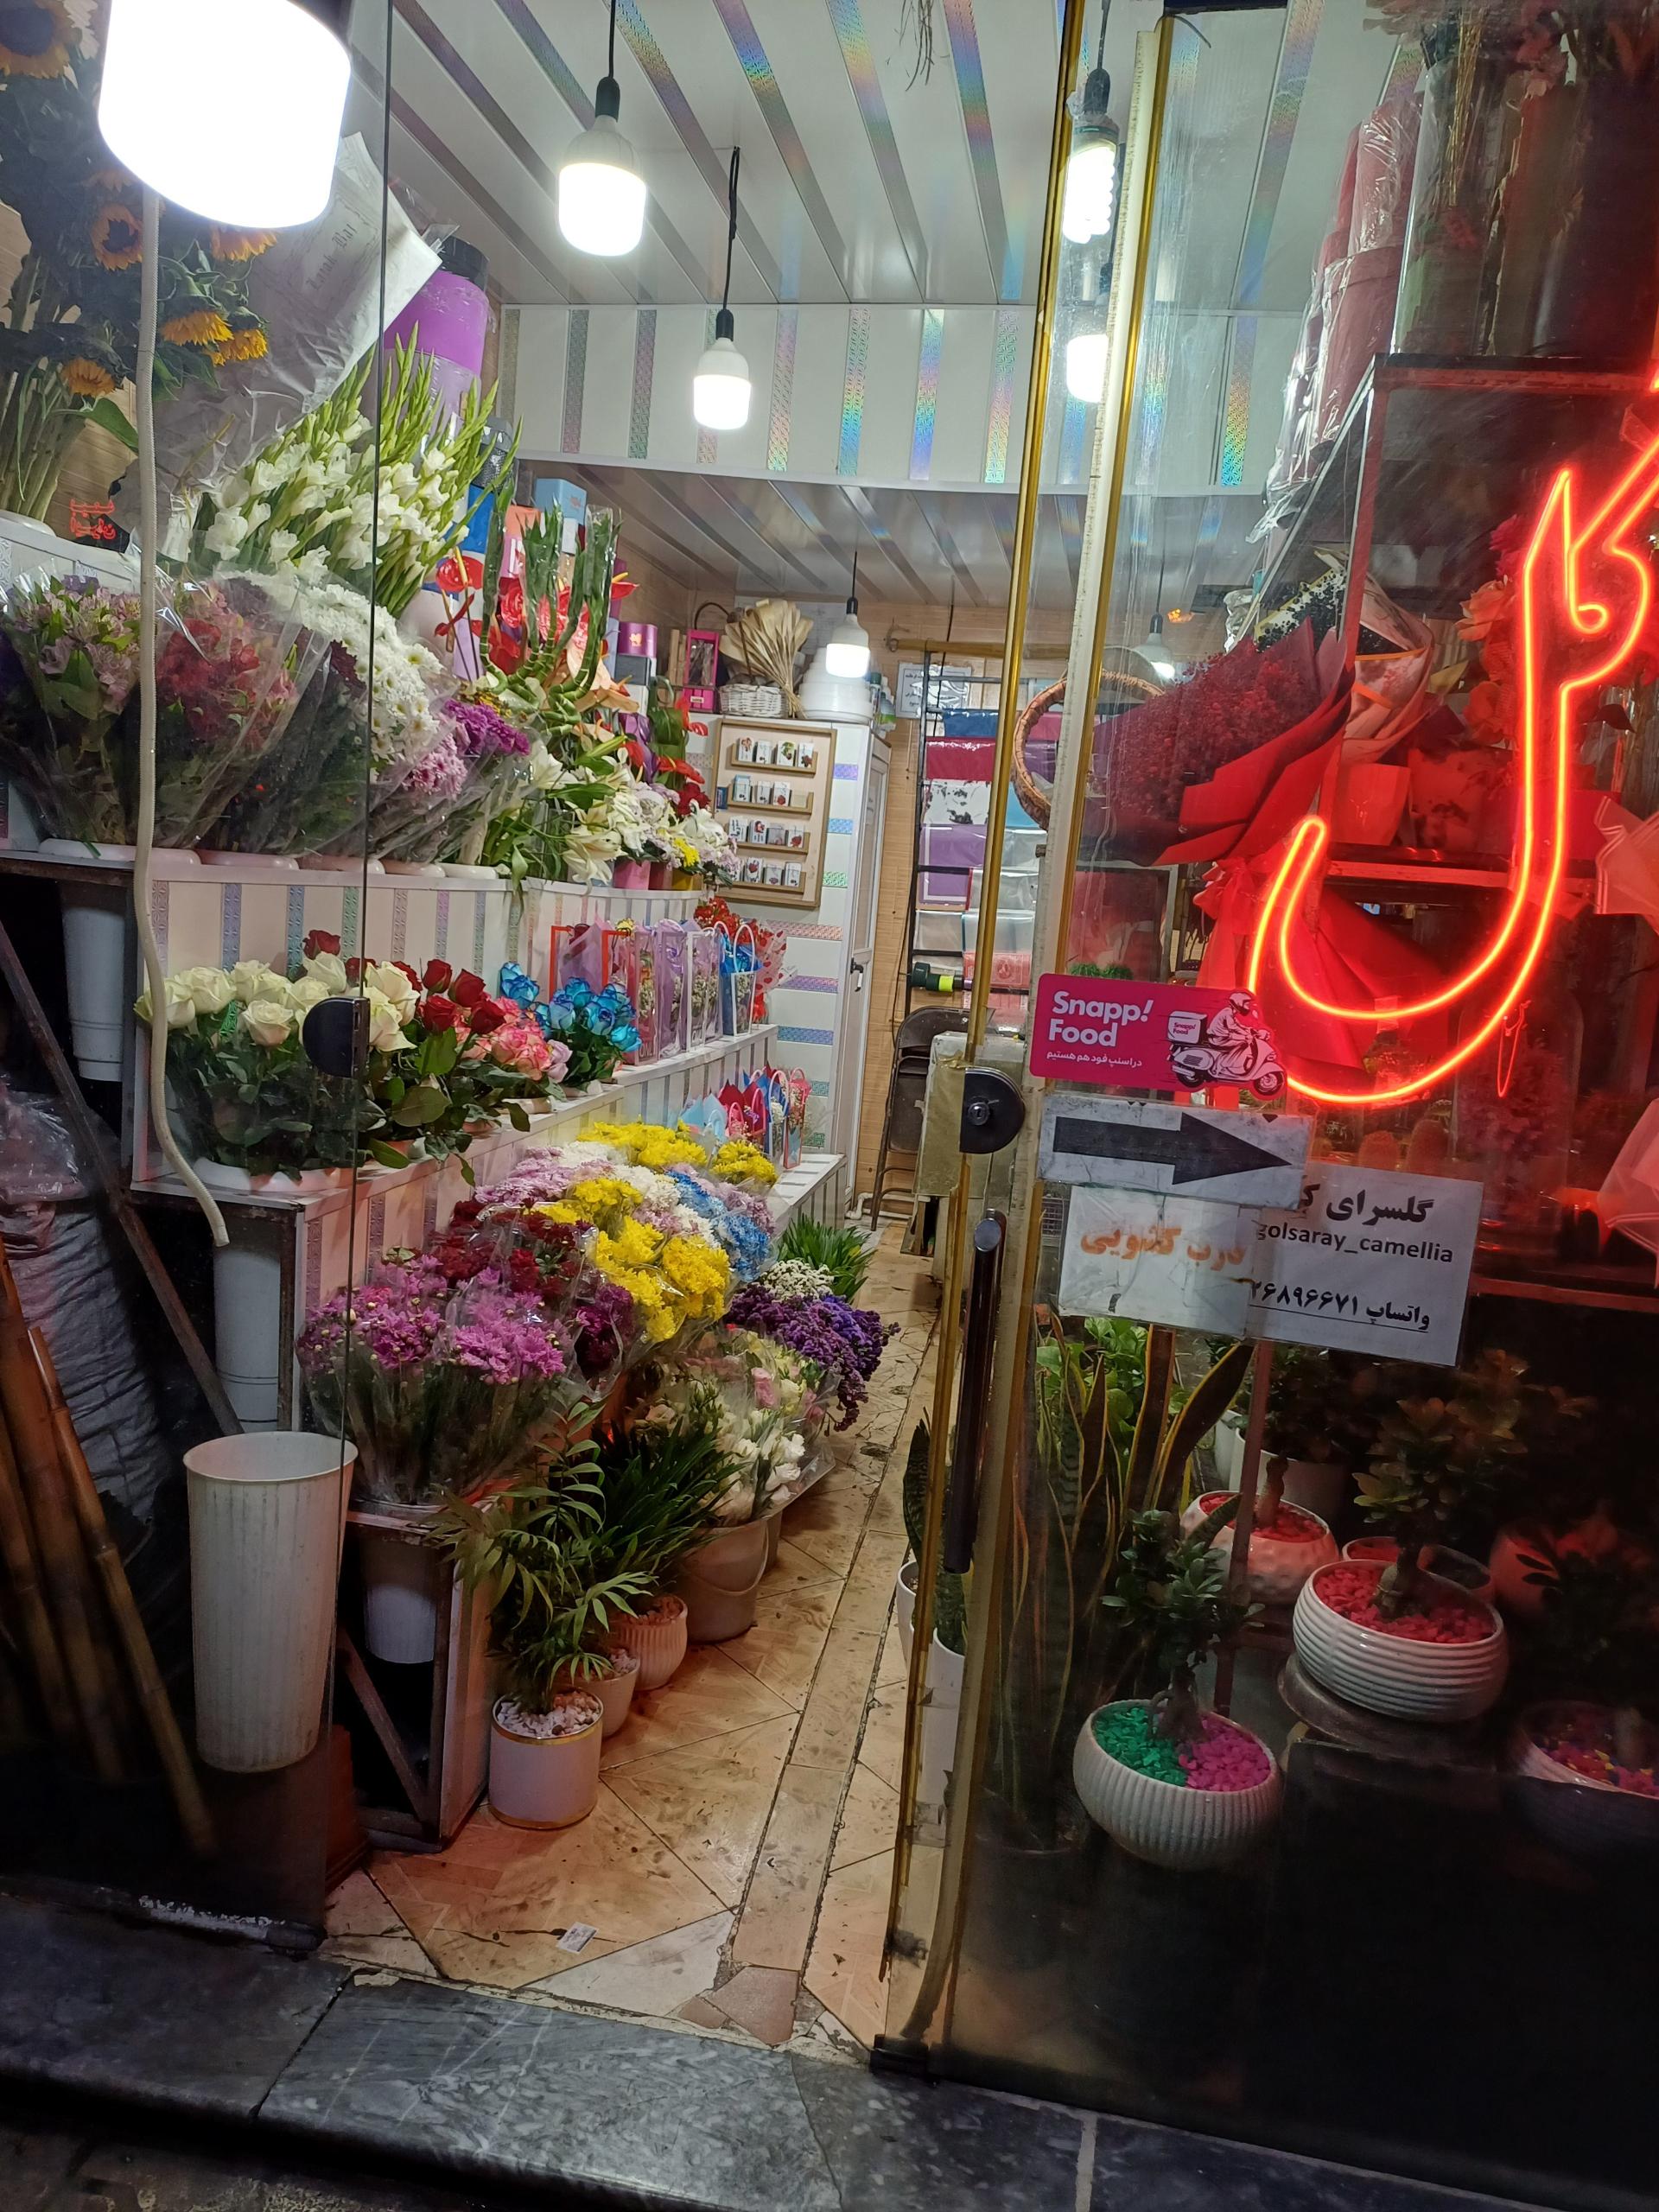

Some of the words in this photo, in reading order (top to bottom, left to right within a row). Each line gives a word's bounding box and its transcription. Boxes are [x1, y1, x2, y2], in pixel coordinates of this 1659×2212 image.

[1052, 991, 1154, 1026] Snapp!
[1048, 1019, 1118, 1047] Food
[1325, 1189, 1435, 1226] گلسرای
